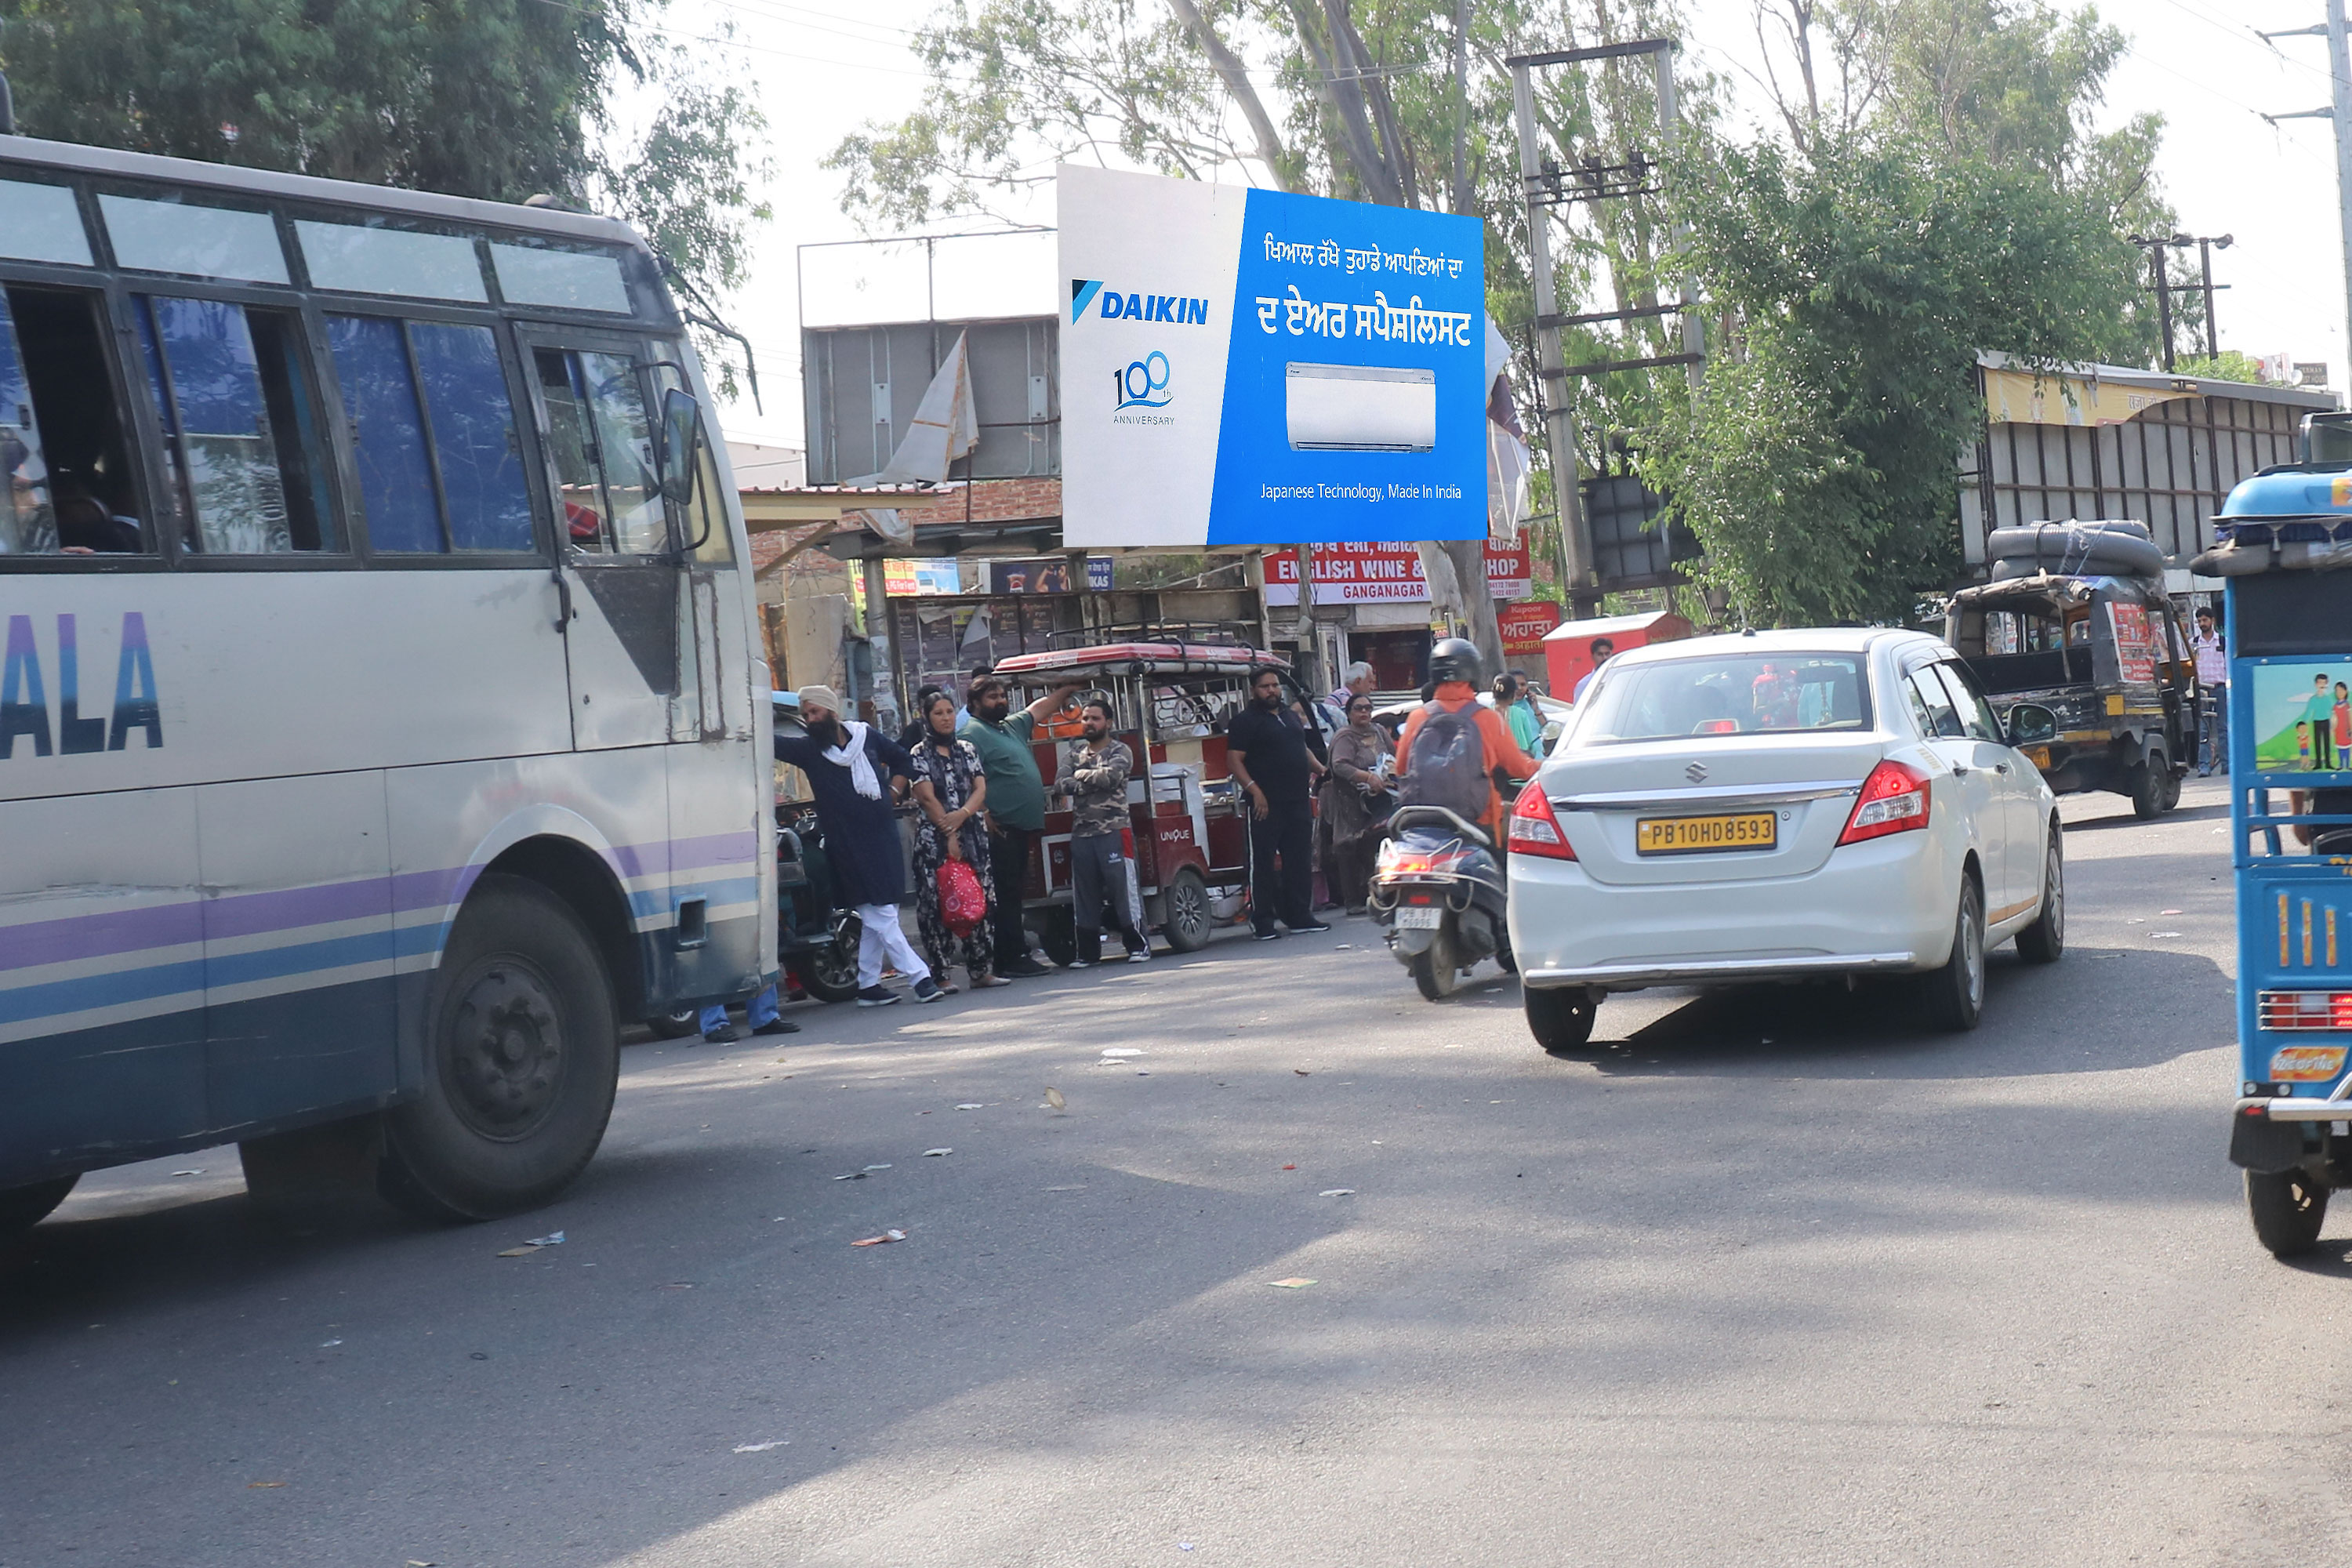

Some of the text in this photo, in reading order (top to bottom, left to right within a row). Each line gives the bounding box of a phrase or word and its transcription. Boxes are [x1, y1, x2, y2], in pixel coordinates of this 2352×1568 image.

[1263, 232, 1315, 266] ਖਿਆਲ
[1345, 243, 1381, 275] ਤੁਹਾਡੇ
[1383, 247, 1445, 278] ਆਪਣਿਆਂ
[1447, 259, 1464, 279] ਦਾ
[1100, 291, 1209, 325] DAIKIN
[1255, 284, 1472, 347] ਦ ਏਅਰ ਸਪੈਸ਼ਲਿਸਟ
[1113, 415, 1175, 426] ANNIVERSARY
[1260, 482, 1462, 503] Japanese Technology, Made In India
[1360, 559, 1406, 579] WINE
[1484, 557, 1519, 576] HOP
[1343, 583, 1424, 598] GANGANAGAR
[1511, 605, 1543, 615] Kapoor
[1501, 620, 1552, 638] ਅਹਾਤਾ
[1160, 829, 1190, 843] UNIQUE
[1652, 819, 1771, 844] PB10HD8593
